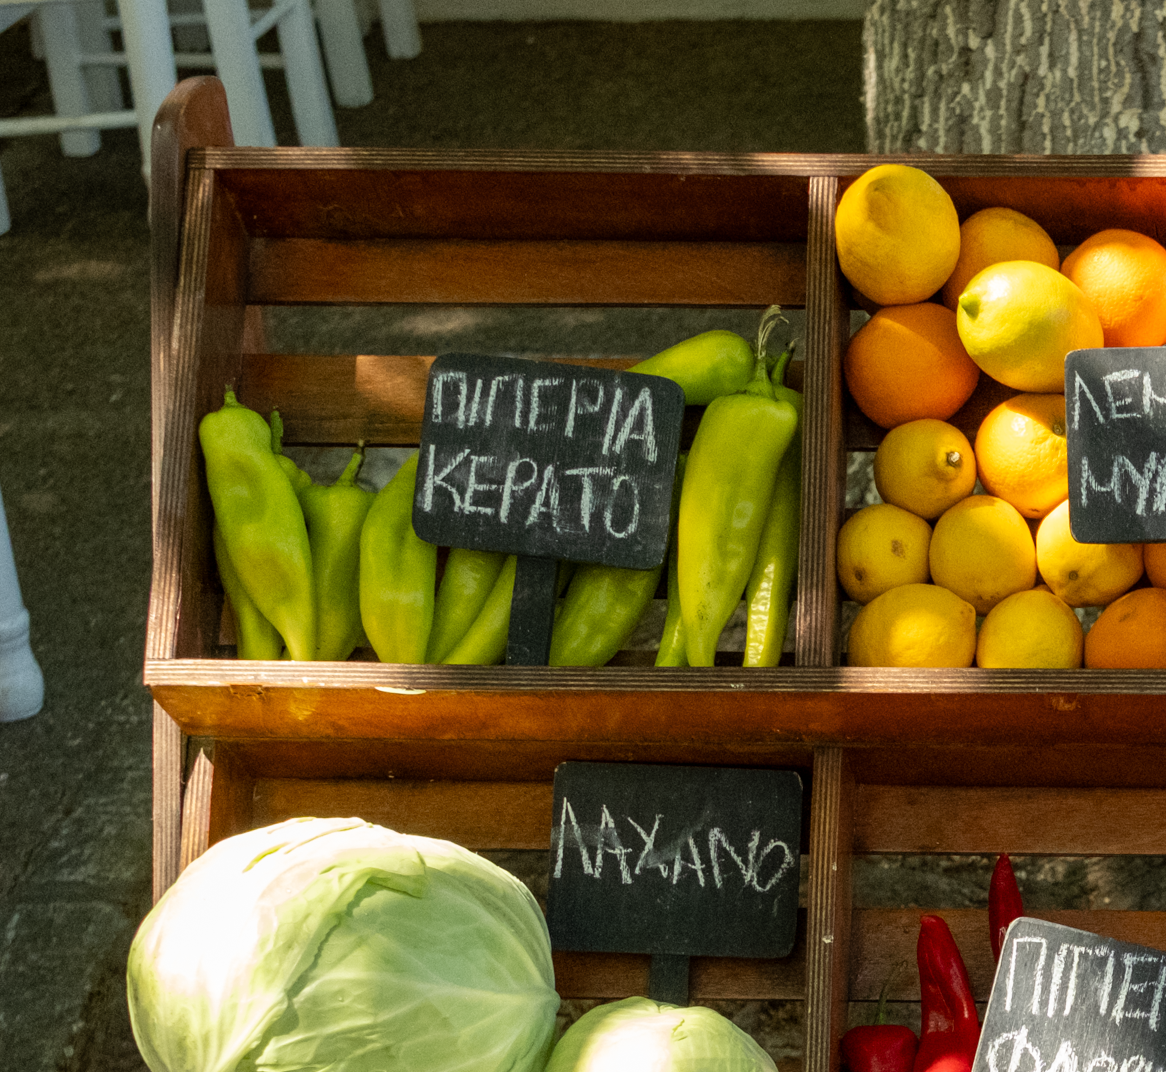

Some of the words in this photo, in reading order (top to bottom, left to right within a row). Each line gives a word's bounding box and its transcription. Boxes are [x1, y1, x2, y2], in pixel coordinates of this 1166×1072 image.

[431, 371, 658, 463] ΠΙΠΕΡΙΑ
[422, 444, 640, 538] ΚΕΡΑΤΟ
[553, 797, 795, 893] ΛΑΧΑΝΟ
